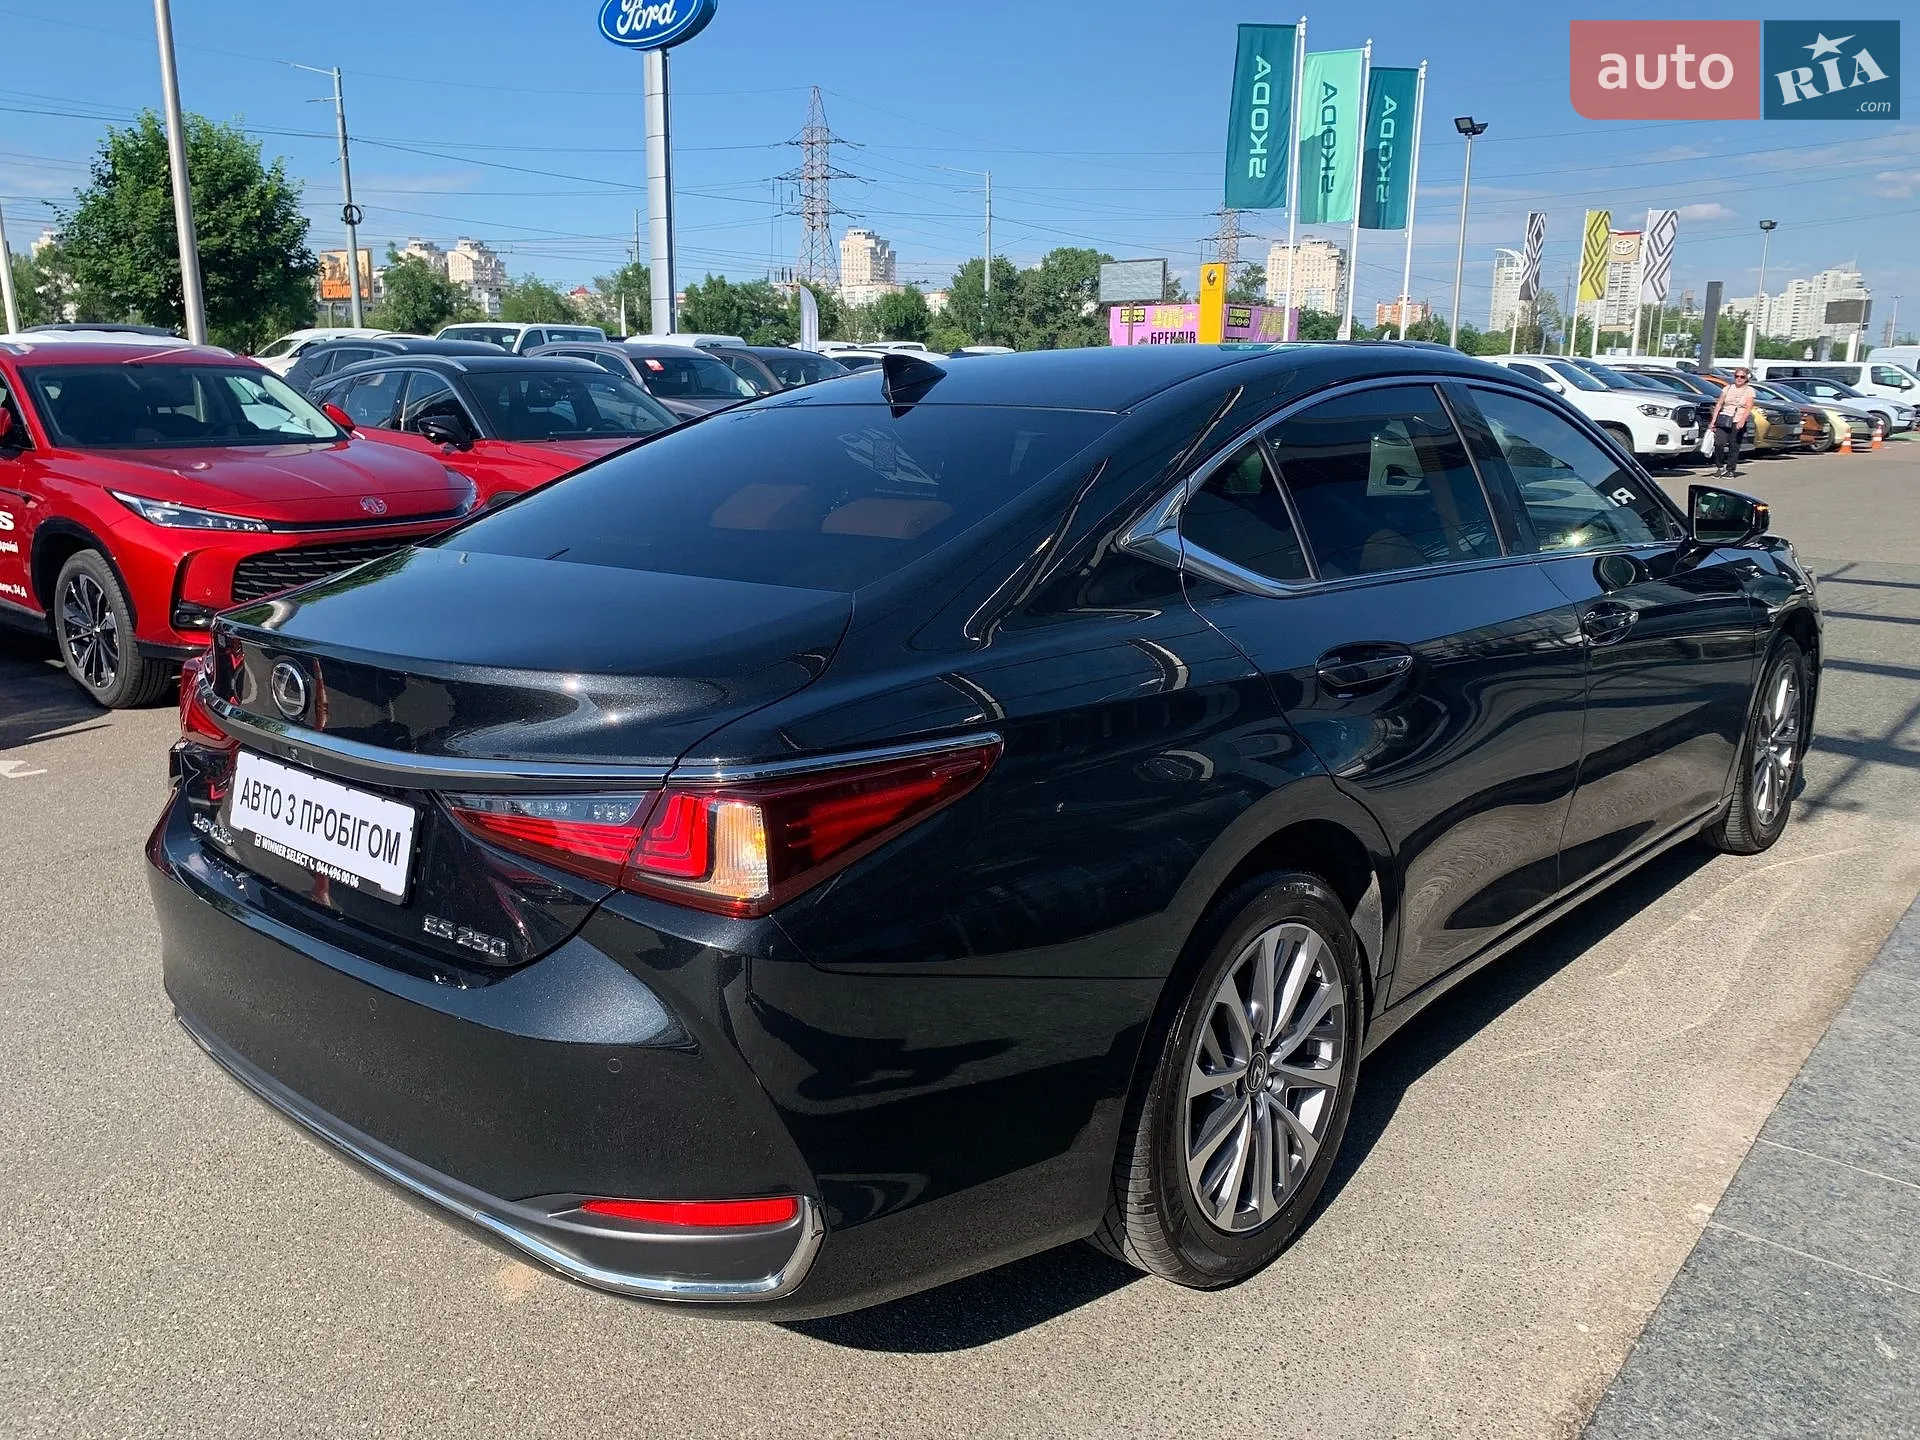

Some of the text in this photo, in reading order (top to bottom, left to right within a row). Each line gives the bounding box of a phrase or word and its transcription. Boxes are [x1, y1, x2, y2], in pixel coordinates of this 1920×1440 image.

[616, 0, 677, 35] Ford
[239, 776, 282, 820] АВТО
[299, 798, 401, 866] ПРОБІГОМ
[261, 836, 360, 888] WINNER SELECT 044 496 00 06
[456, 926, 509, 957] 250
